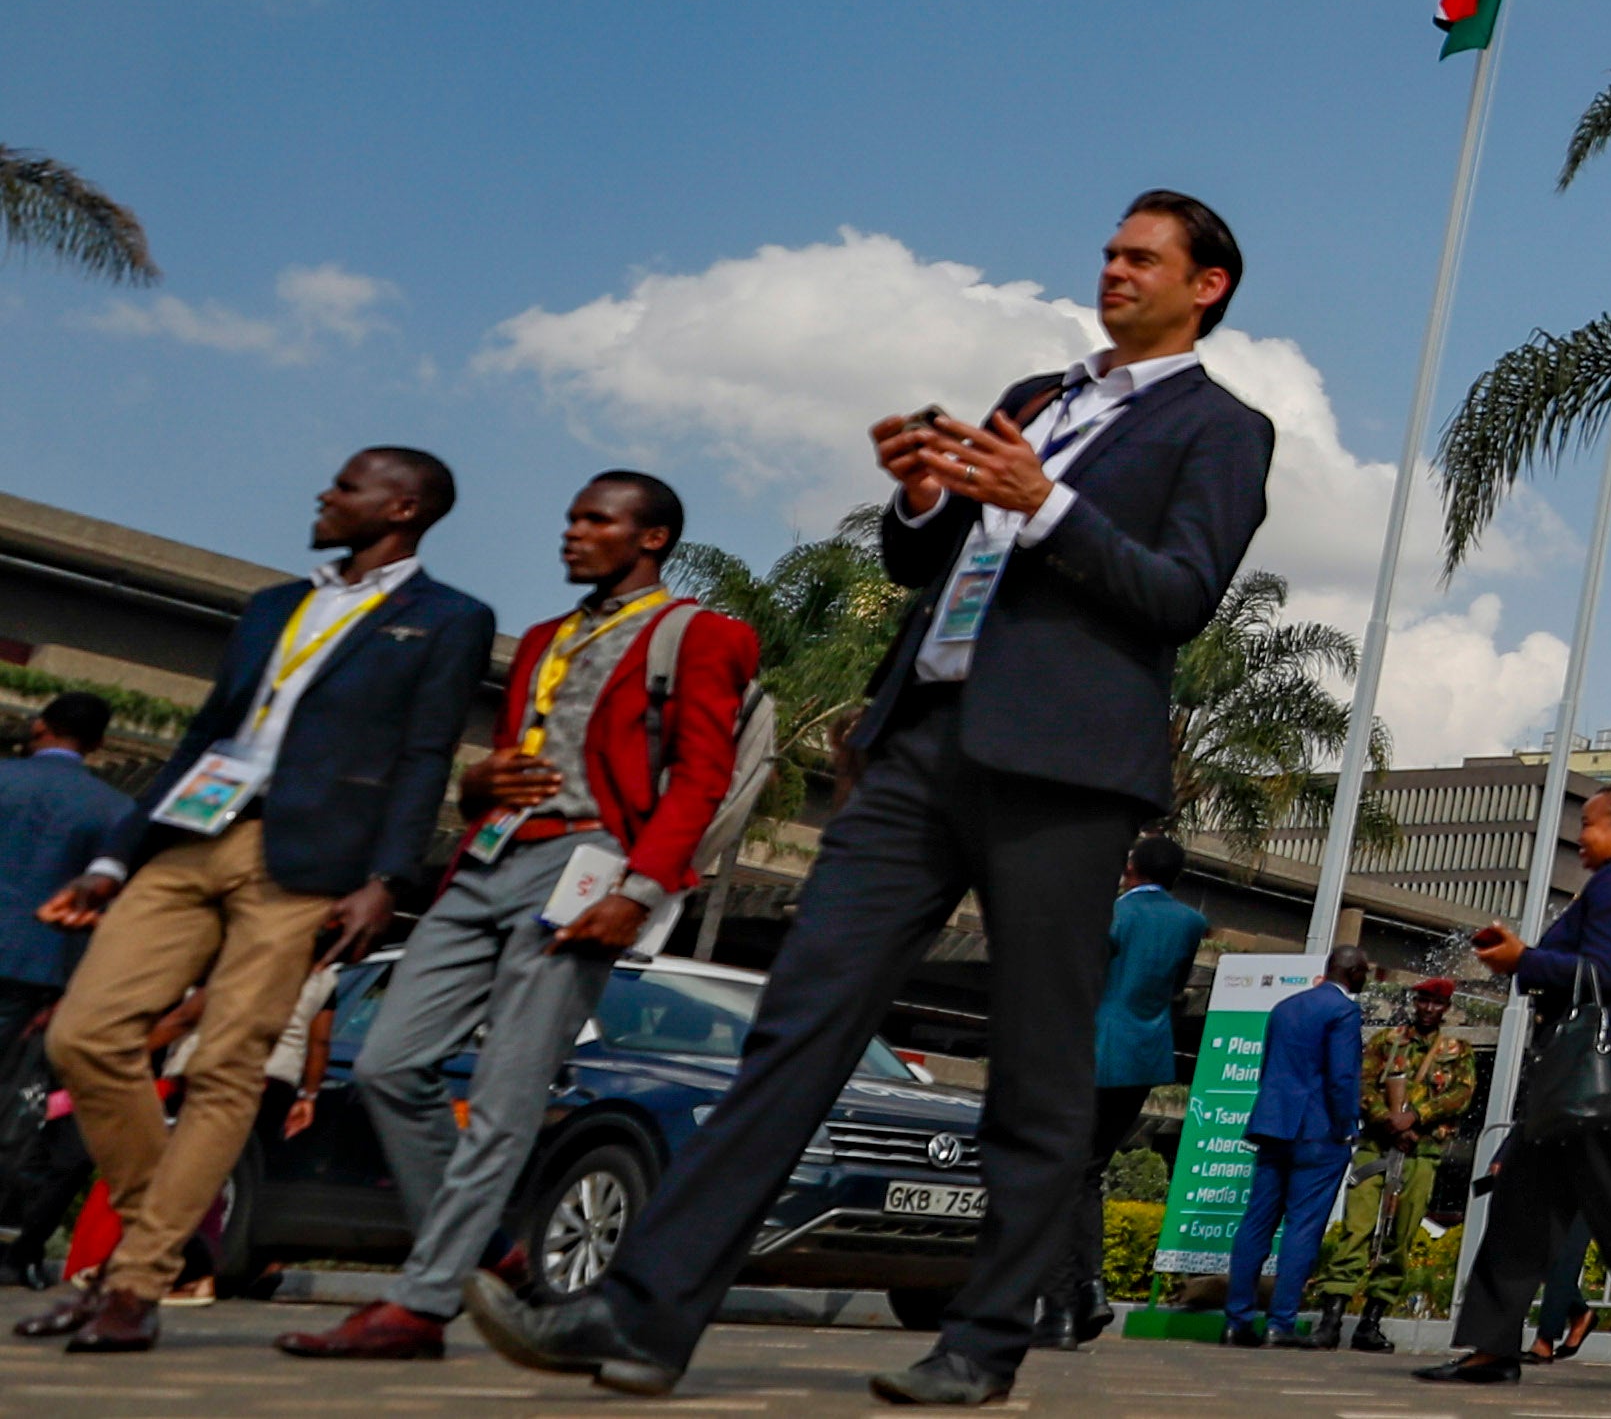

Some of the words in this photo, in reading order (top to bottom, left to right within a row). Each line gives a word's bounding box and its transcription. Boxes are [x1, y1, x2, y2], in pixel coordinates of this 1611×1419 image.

[1228, 1037, 1262, 1055] Plen
[1222, 1064, 1261, 1081] Main
[891, 1187, 930, 1211] GKB
[1196, 1186, 1237, 1203] Media
[1241, 1189, 1250, 1203] C
[1191, 1222, 1221, 1240] Expo
